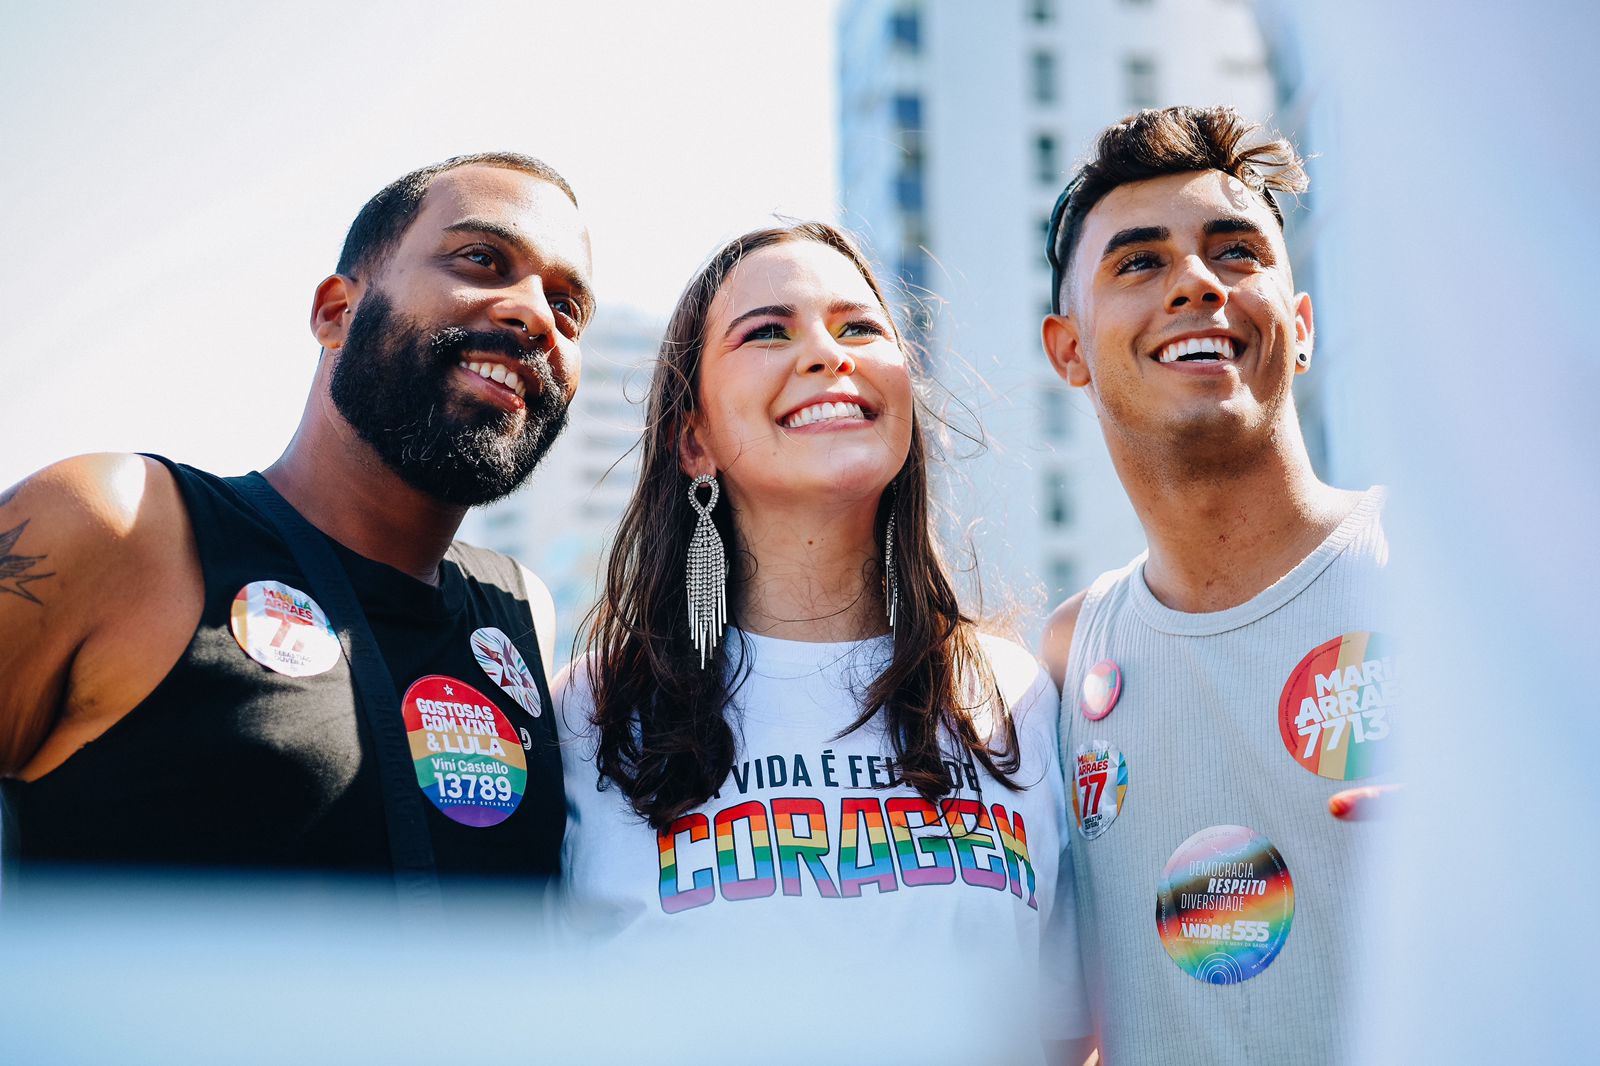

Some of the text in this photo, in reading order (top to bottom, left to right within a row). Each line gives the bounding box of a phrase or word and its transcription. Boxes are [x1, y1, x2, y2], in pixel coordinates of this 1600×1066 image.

[265, 598, 313, 620] ARRAES
[415, 697, 495, 721] GOSTOSAS
[421, 713, 499, 736] COM VINI
[426, 732, 506, 757] & LULA
[431, 757, 509, 774] Vini Castello
[731, 754, 812, 794] VIDA
[820, 749, 839, 787] É
[1079, 760, 1108, 776] ARRAES
[434, 771, 512, 802] 13789
[1079, 771, 1107, 818] 77
[657, 797, 1038, 914] CORAGEM
[1189, 861, 1254, 879] DEMOCRACIA
[1207, 878, 1267, 896] RESPEITO
[1181, 893, 1244, 912] DIVERSIDADE
[1232, 919, 1270, 943] 555
